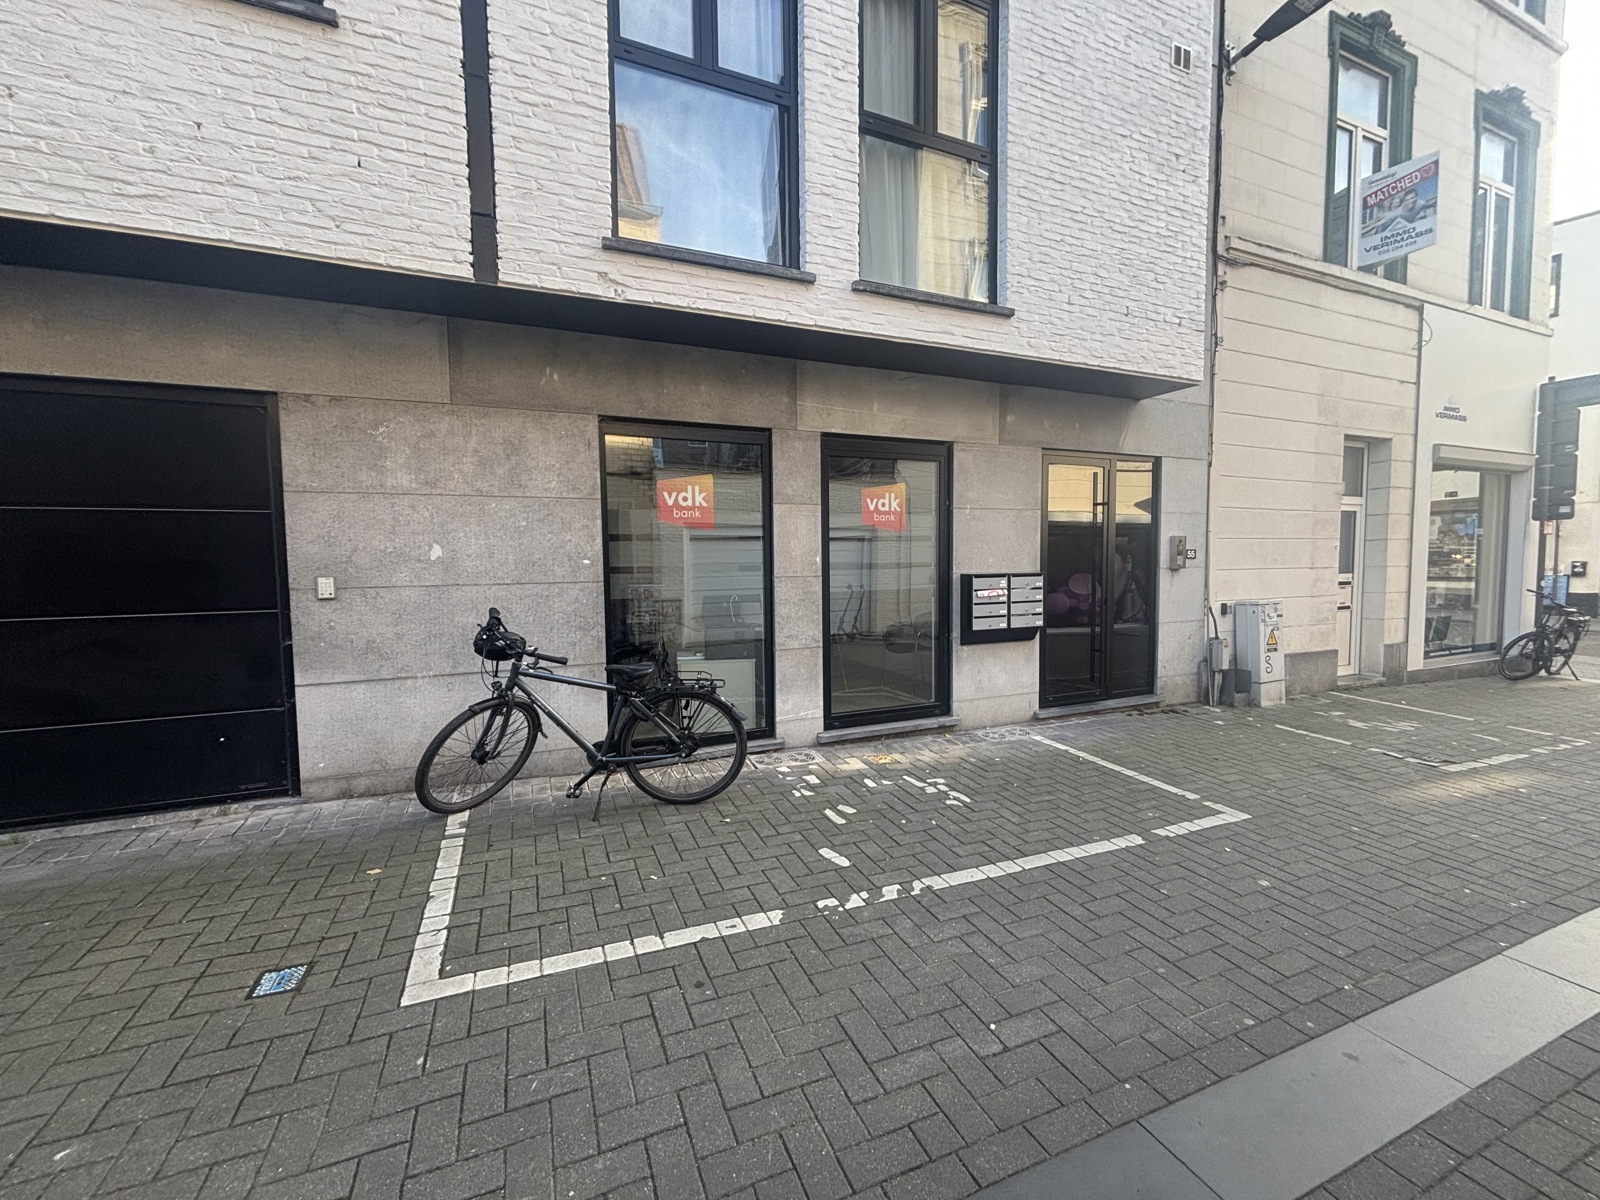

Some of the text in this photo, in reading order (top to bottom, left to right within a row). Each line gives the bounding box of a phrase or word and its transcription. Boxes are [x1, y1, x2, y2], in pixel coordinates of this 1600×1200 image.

[1366, 171, 1421, 207] MATCHED
[1364, 227, 1433, 253] VERIMASS
[1380, 227, 1416, 243] IMMO
[1443, 405, 1460, 414] IMMO
[662, 485, 708, 507] vdk
[866, 492, 901, 512] vdk
[673, 508, 701, 518] bank
[873, 512, 896, 521] bank
[1187, 550, 1195, 558] 55
